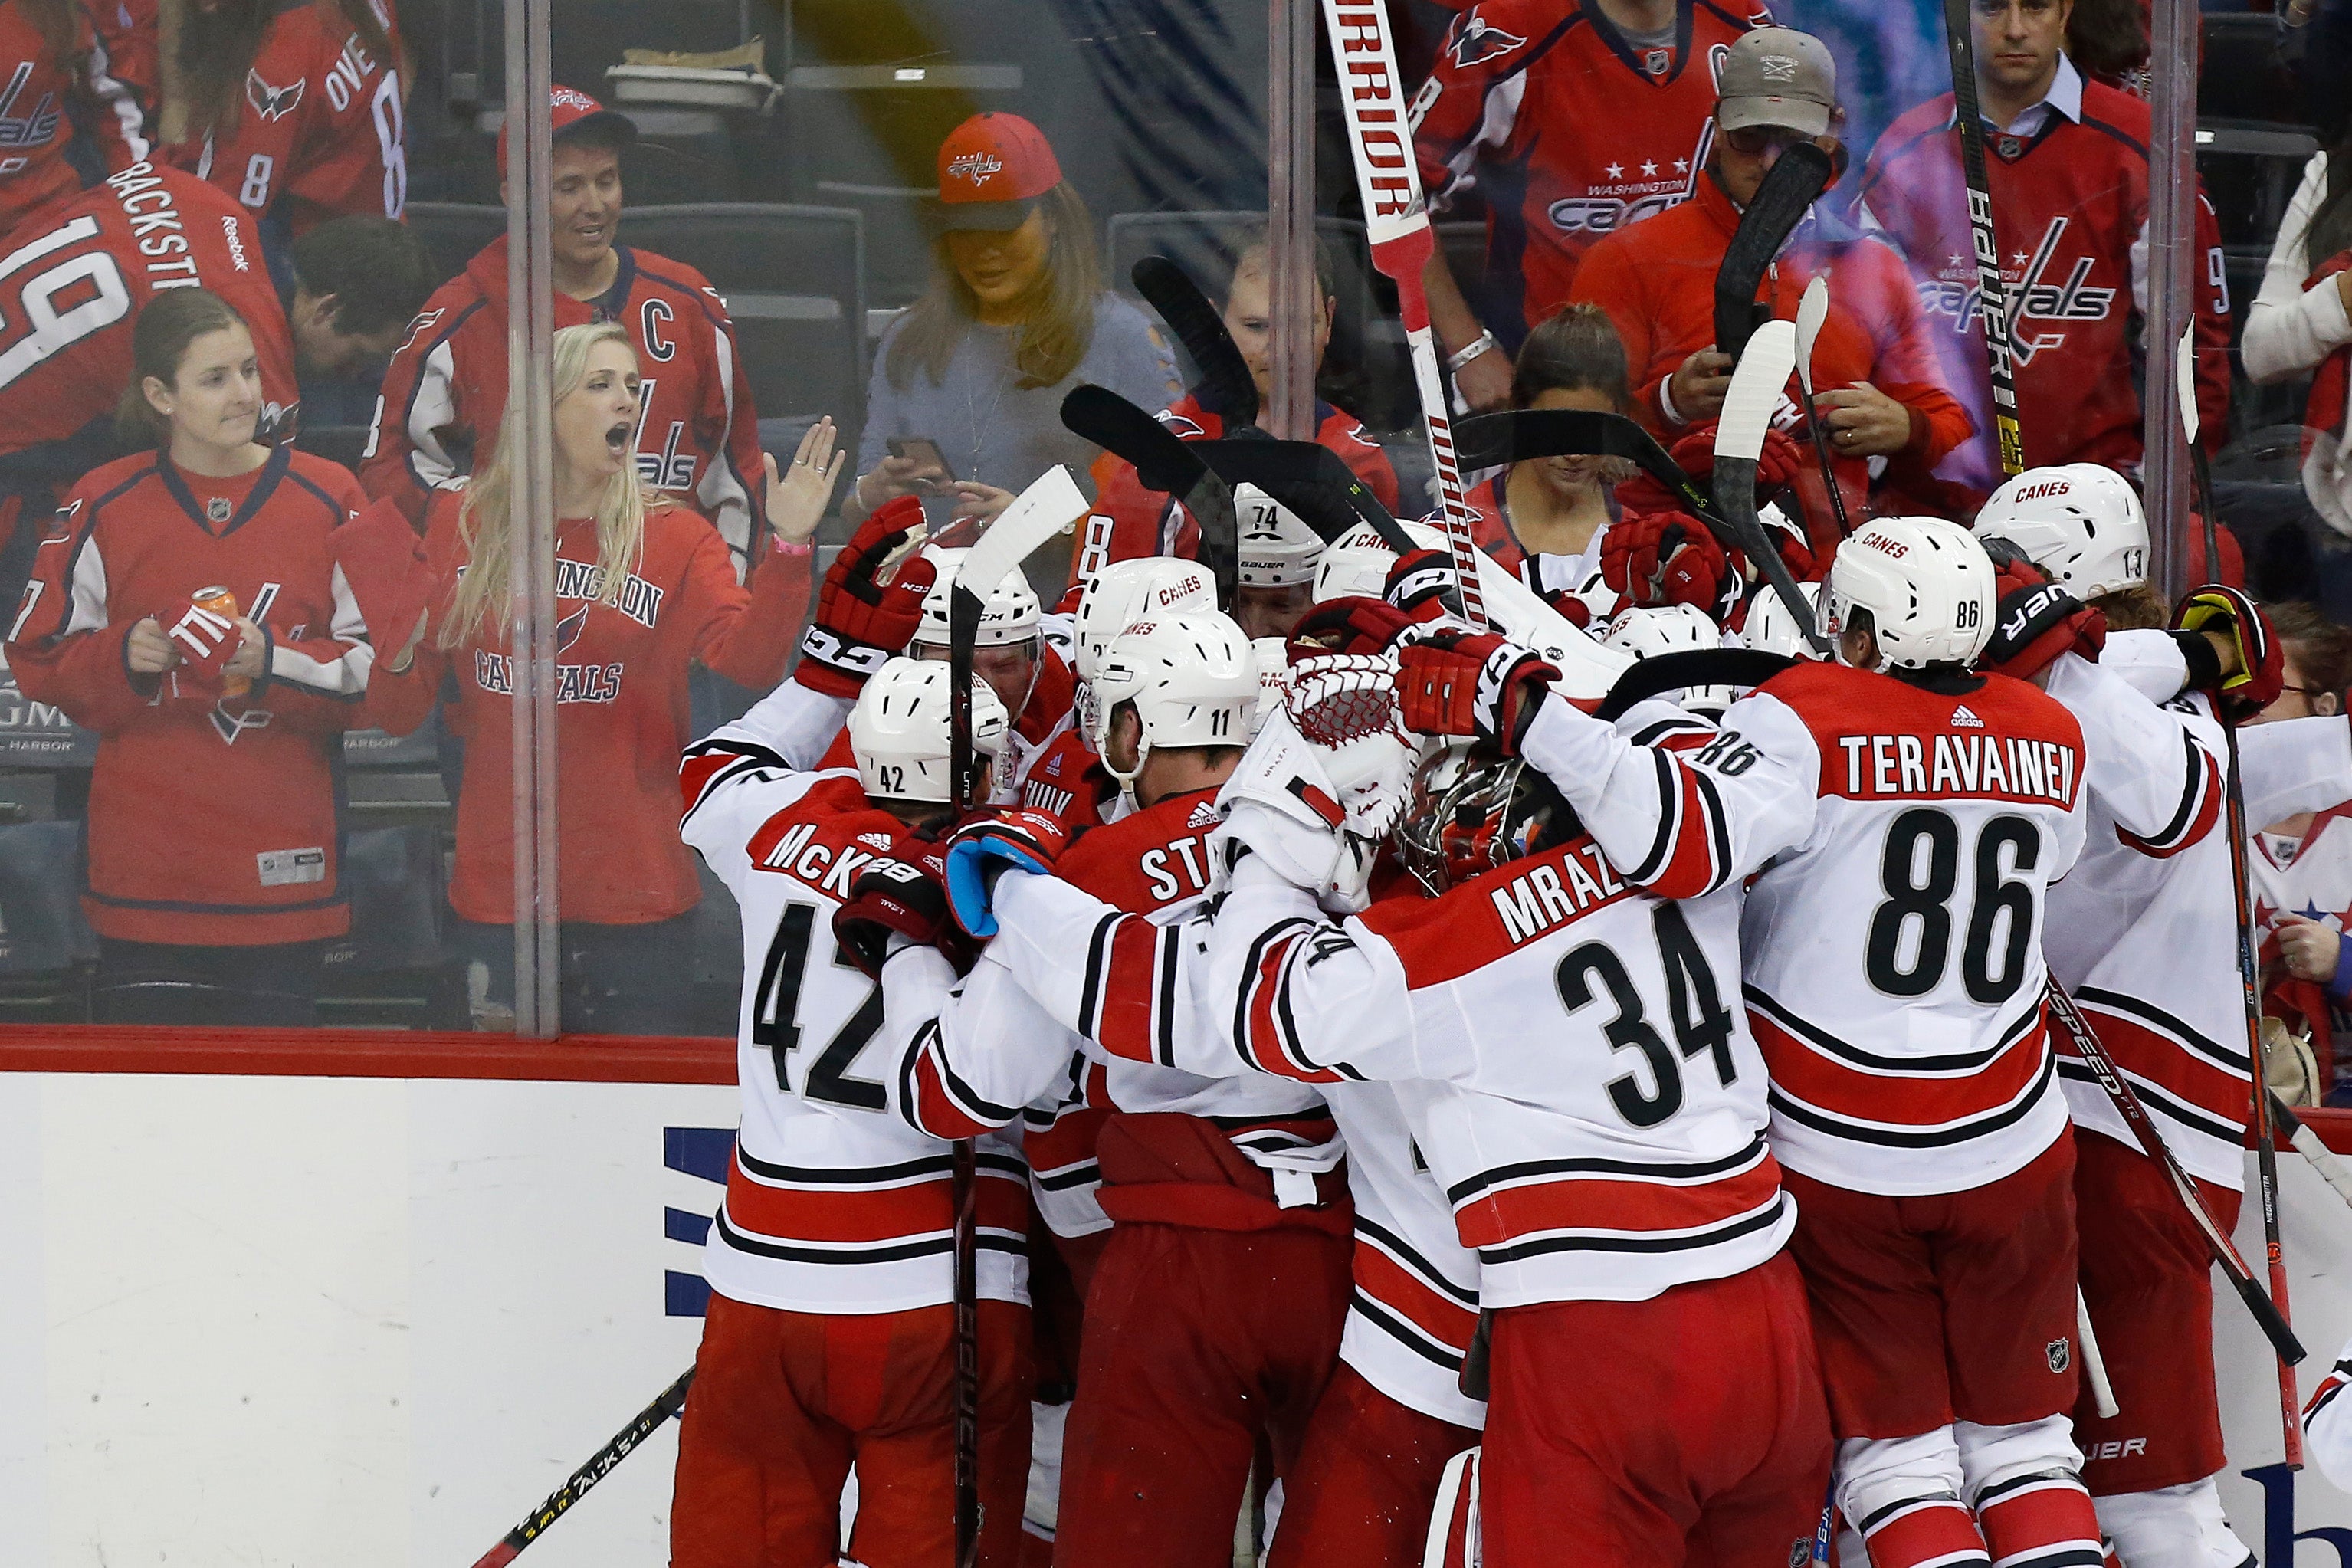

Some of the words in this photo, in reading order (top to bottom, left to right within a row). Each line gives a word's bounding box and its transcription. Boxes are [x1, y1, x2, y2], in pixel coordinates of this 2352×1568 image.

[1334, 0, 1415, 220] RRIOR
[239, 153, 274, 208] 8
[1587, 179, 1688, 195] WASHINGTON
[221, 215, 249, 273] Reebok
[641, 298, 674, 362] C
[2014, 481, 2071, 504] CANES
[1253, 506, 1278, 530] 74
[1077, 515, 1114, 581] 8
[1862, 533, 1909, 559] CANES
[2124, 549, 2142, 578] 13
[8, 580, 44, 641] 7
[1159, 576, 1202, 606] CANES
[2001, 584, 2075, 642] UER
[979, 613, 1005, 622] CM
[1956, 600, 1979, 628] 86
[1211, 708, 1230, 736] 11
[1950, 716, 1984, 728] adidas
[1696, 731, 1763, 776] 86
[1839, 734, 2075, 805] TERAVAINEN
[880, 766, 905, 792] 42
[1862, 805, 2042, 1004] 86
[753, 898, 890, 1114] 42
[1553, 897, 1738, 1130] 34
[2047, 985, 2122, 1097] SPEED
[2081, 1437, 2147, 1461] UER
